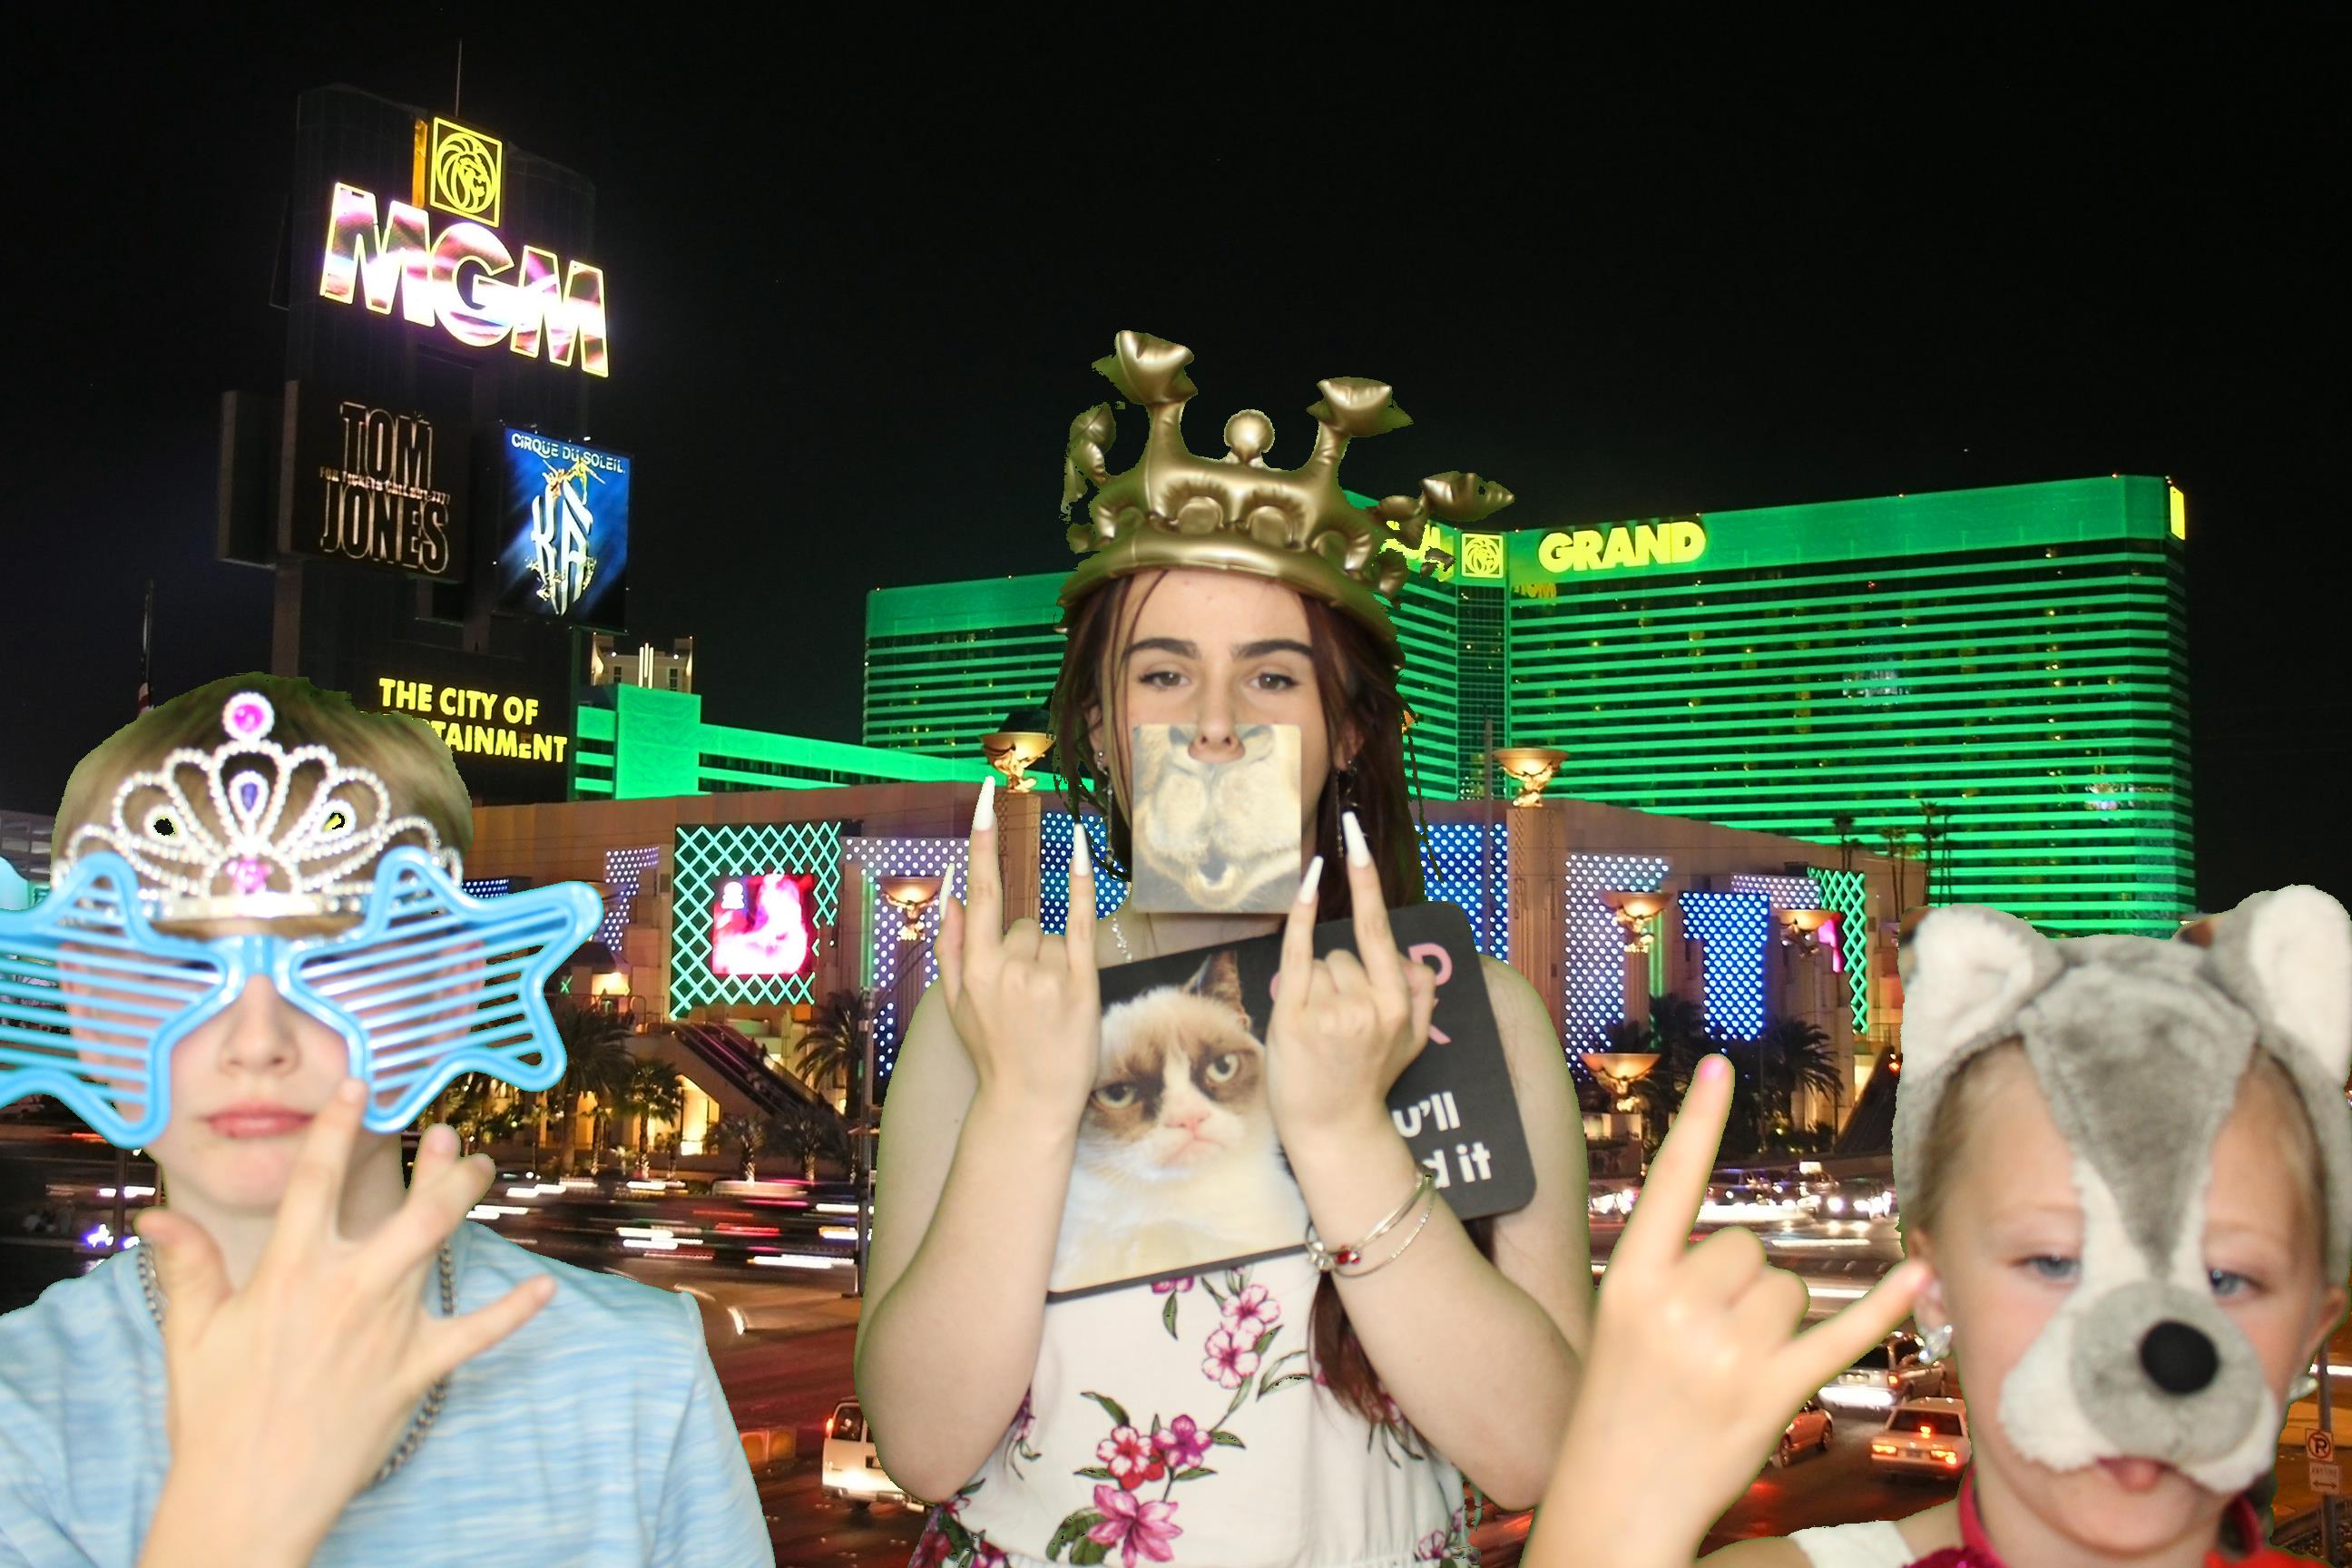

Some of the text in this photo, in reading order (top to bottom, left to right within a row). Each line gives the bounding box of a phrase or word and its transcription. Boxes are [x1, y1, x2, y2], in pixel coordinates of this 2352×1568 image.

[319, 182, 609, 377] MGM
[338, 401, 433, 490] TOM
[511, 433, 624, 474] CIRQUE DU SOLEIL
[319, 479, 449, 573] JONES
[1538, 521, 1707, 573] GRAND
[378, 677, 539, 726] THE CITY OF
[1455, 1142, 1492, 1183] it
